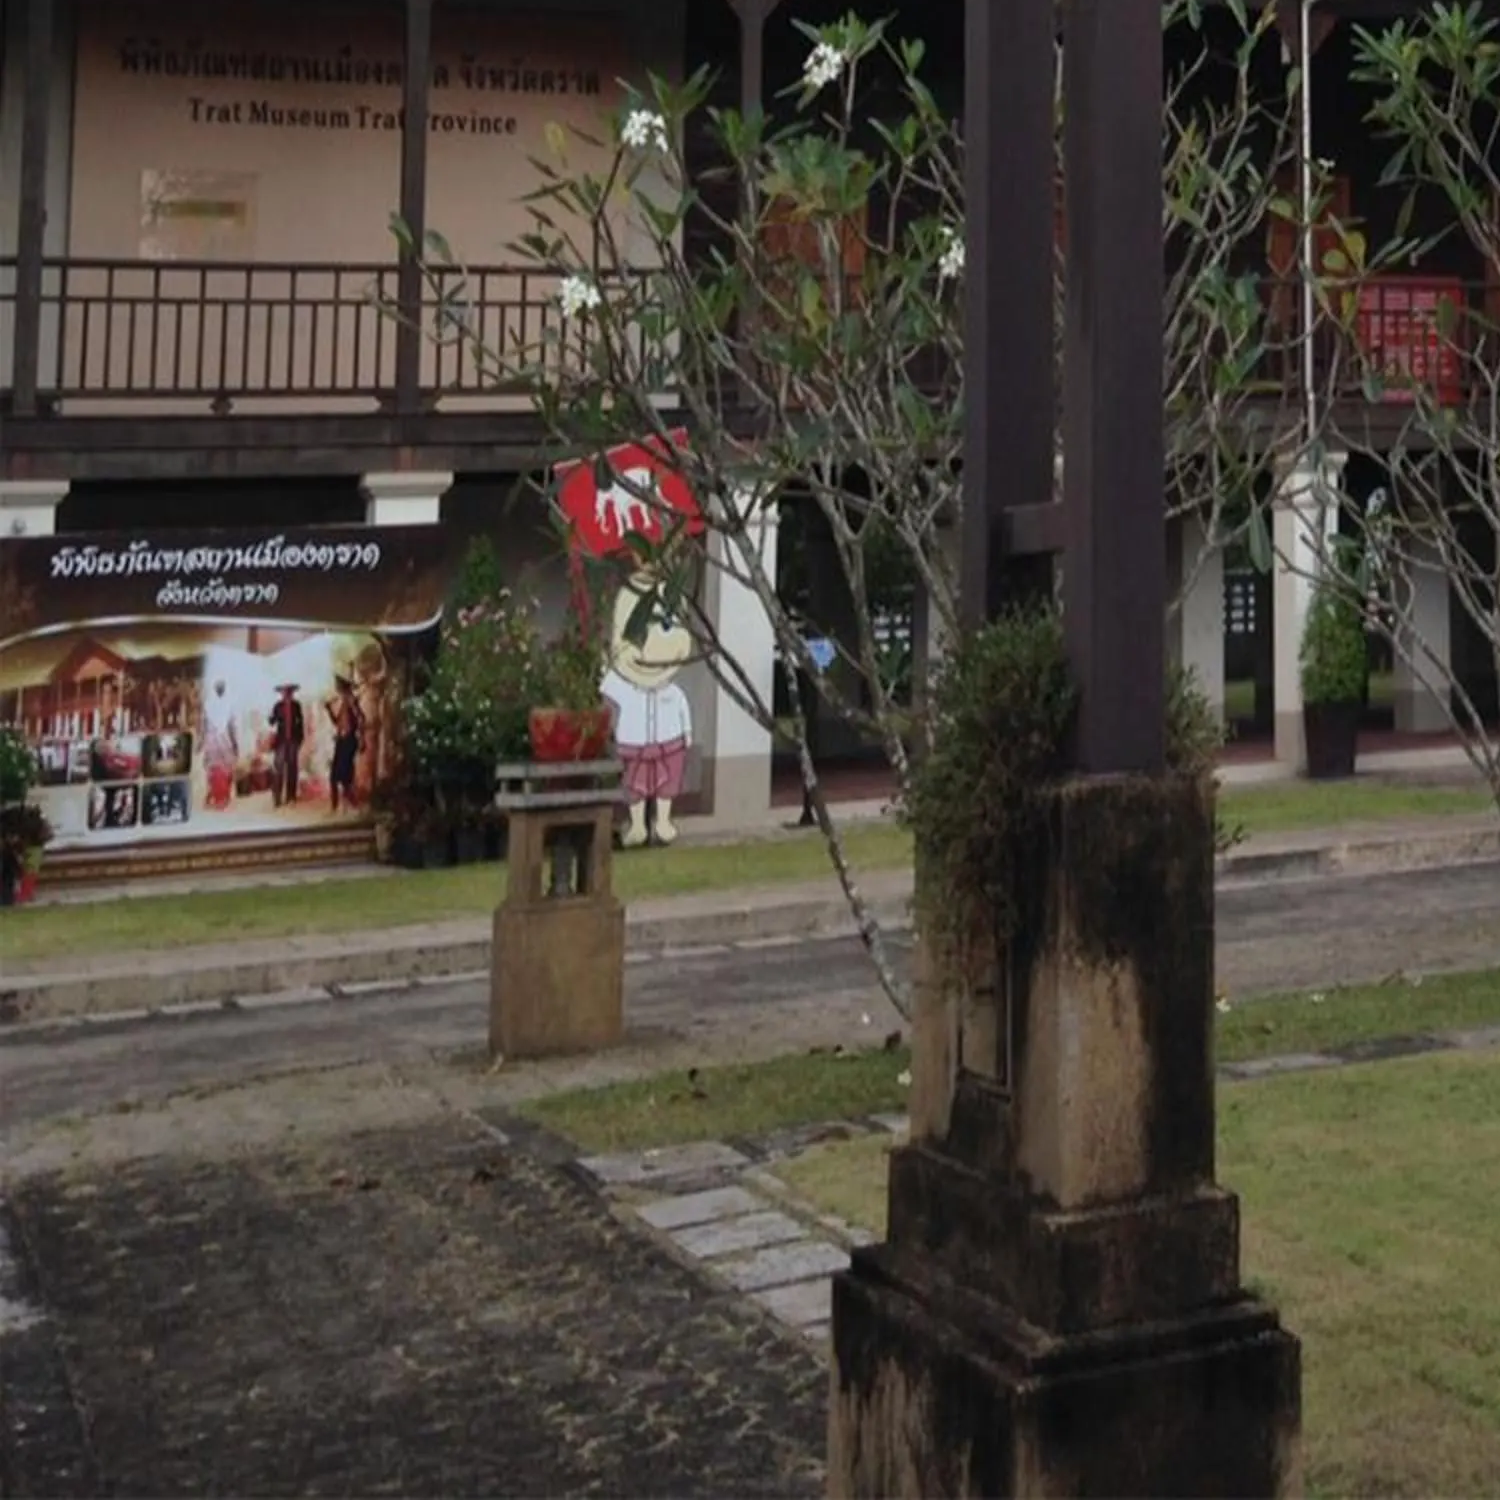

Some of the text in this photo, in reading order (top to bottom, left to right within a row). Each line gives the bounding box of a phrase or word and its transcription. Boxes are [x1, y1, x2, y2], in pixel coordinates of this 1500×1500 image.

[188, 97, 241, 123] Trat
[249, 99, 350, 129] Museum
[421, 109, 517, 135] rovince
